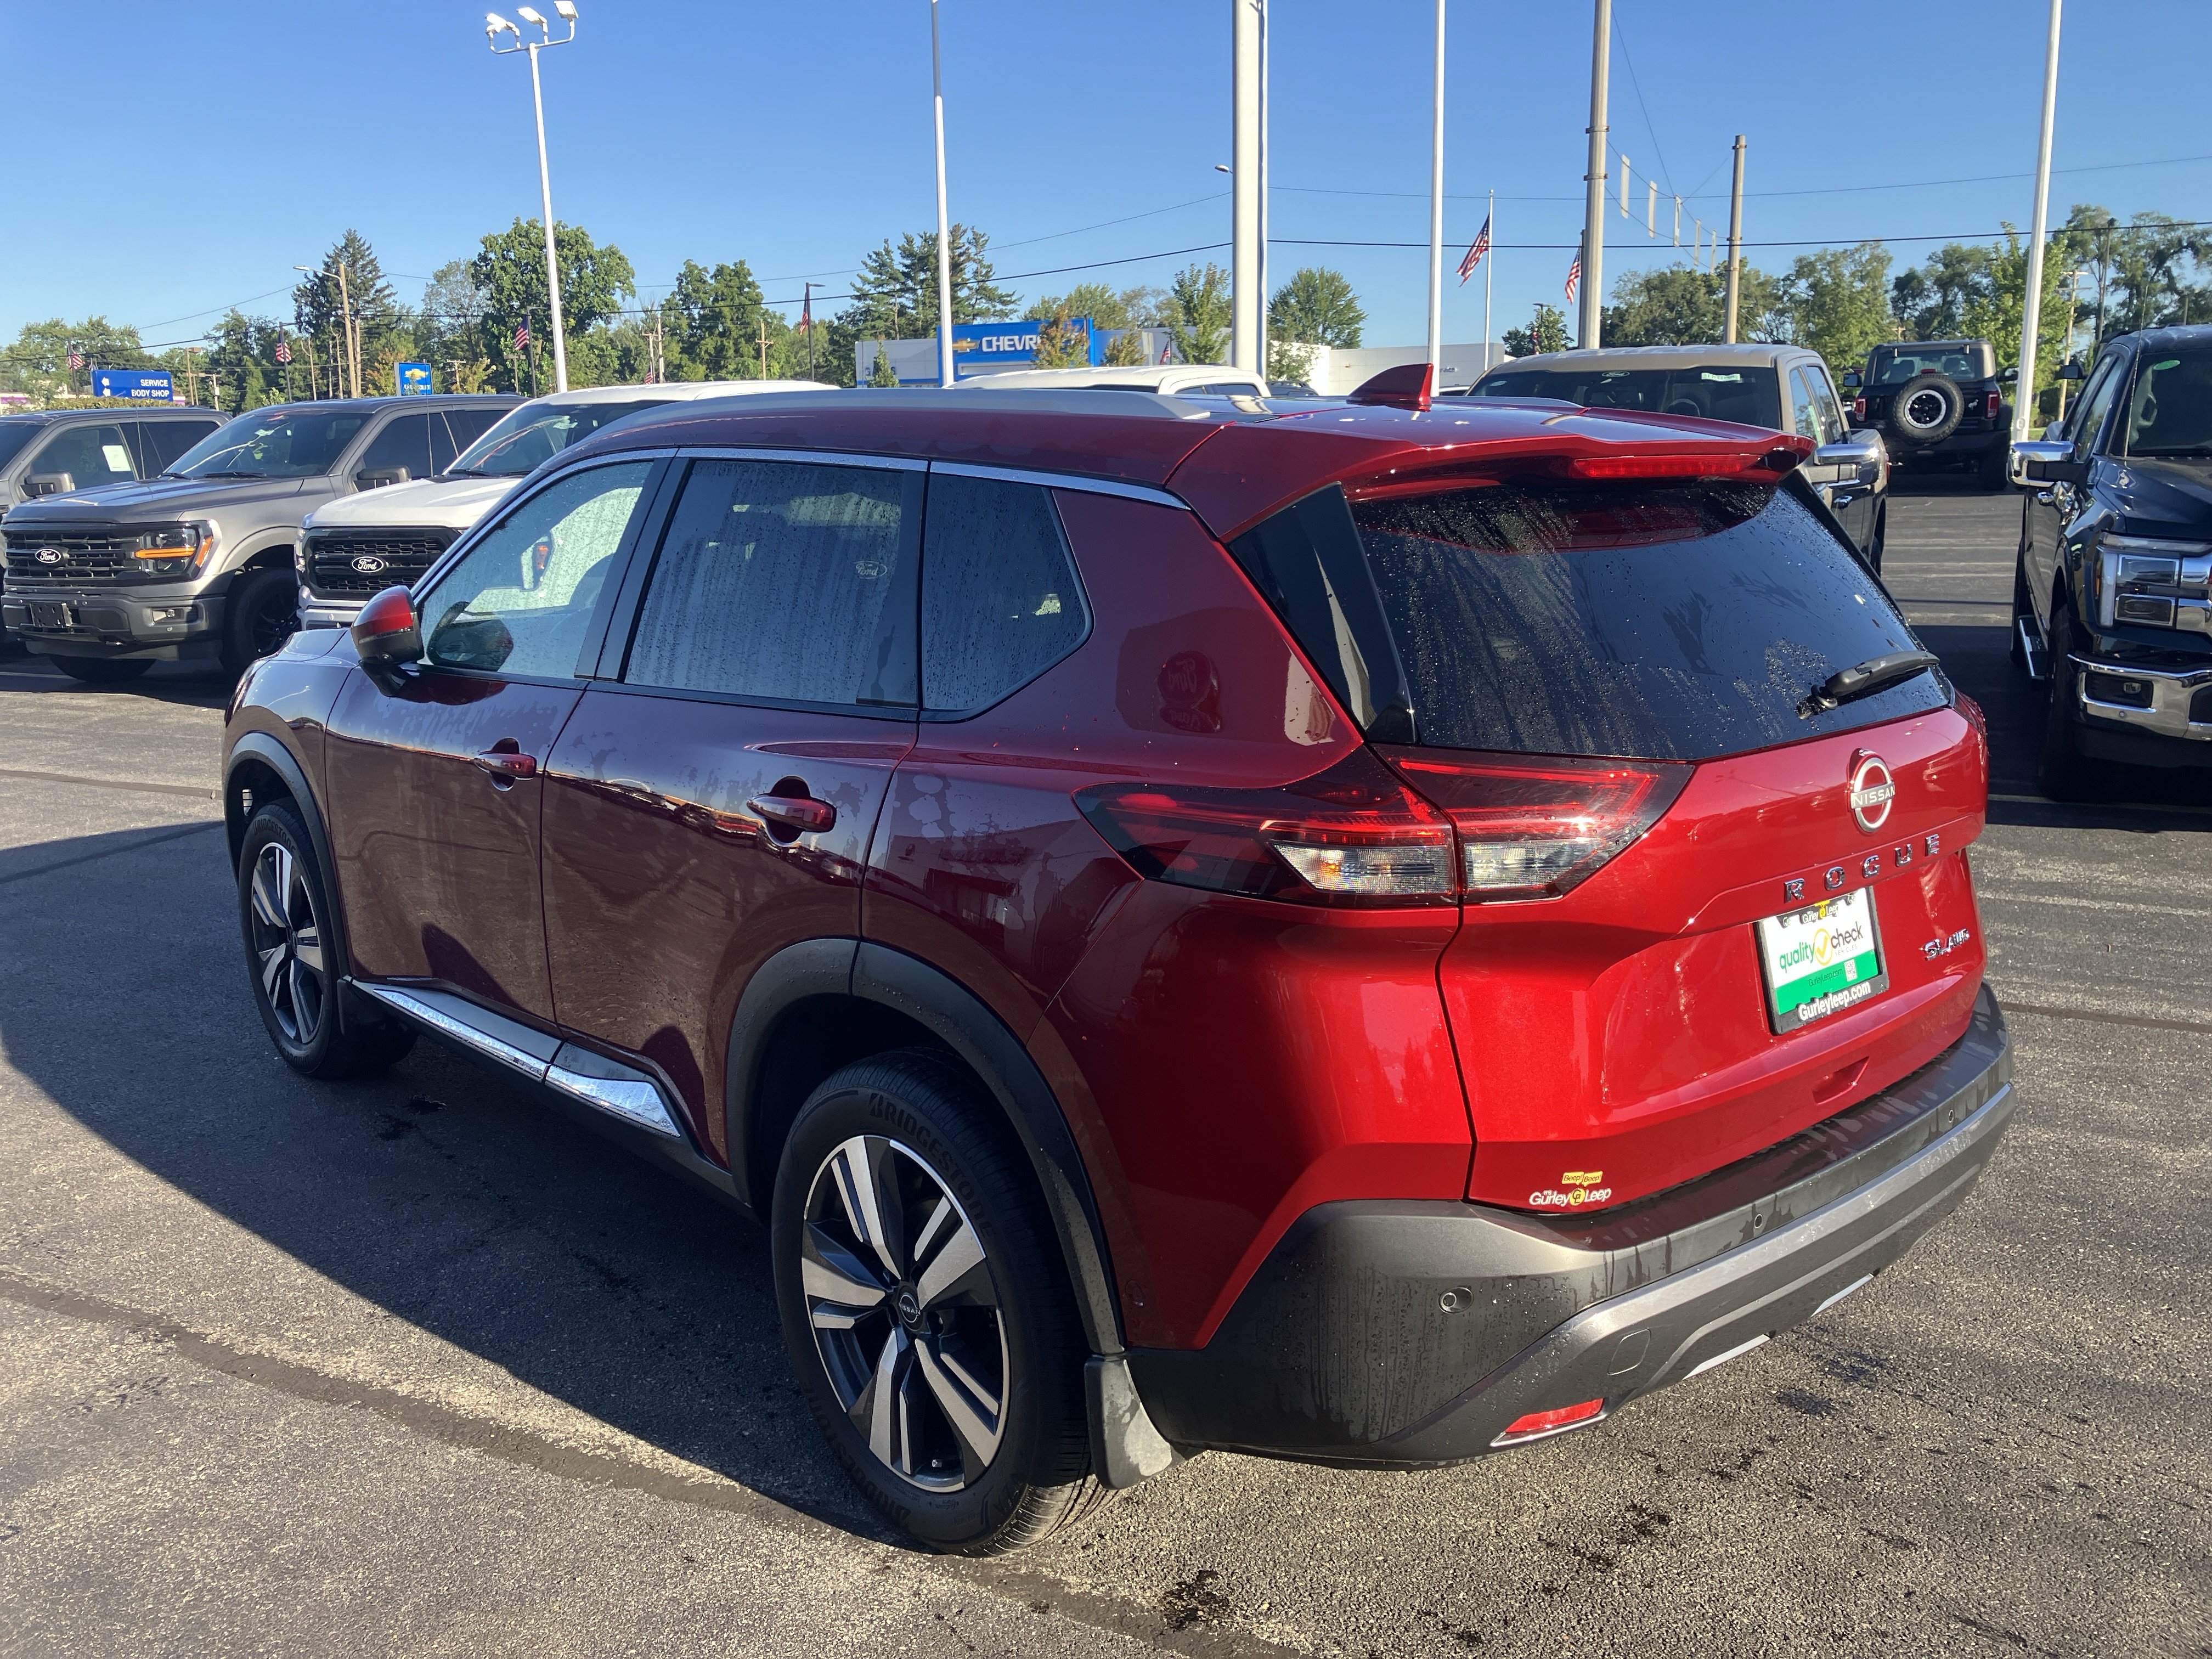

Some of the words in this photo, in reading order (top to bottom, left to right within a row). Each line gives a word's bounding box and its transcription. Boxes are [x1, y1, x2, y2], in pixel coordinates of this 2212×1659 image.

[40, 550, 56, 560] Ford
[358, 558, 377, 569] Ford
[856, 563, 879, 576] Ford
[1852, 785, 1895, 806] NISSAN
[254, 819, 296, 854] BRIDGESTONE
[1784, 833, 1940, 903] ROGUE
[1779, 941, 1815, 974] quality
[1831, 921, 1863, 949] check
[1924, 938, 1951, 961] SL
[1798, 981, 1871, 1021] Gurleyleep.com
[869, 1092, 995, 1238] BRIDGESTONE
[1528, 1190, 1571, 1207] Gurley
[1584, 1188, 1612, 1203] Leep
